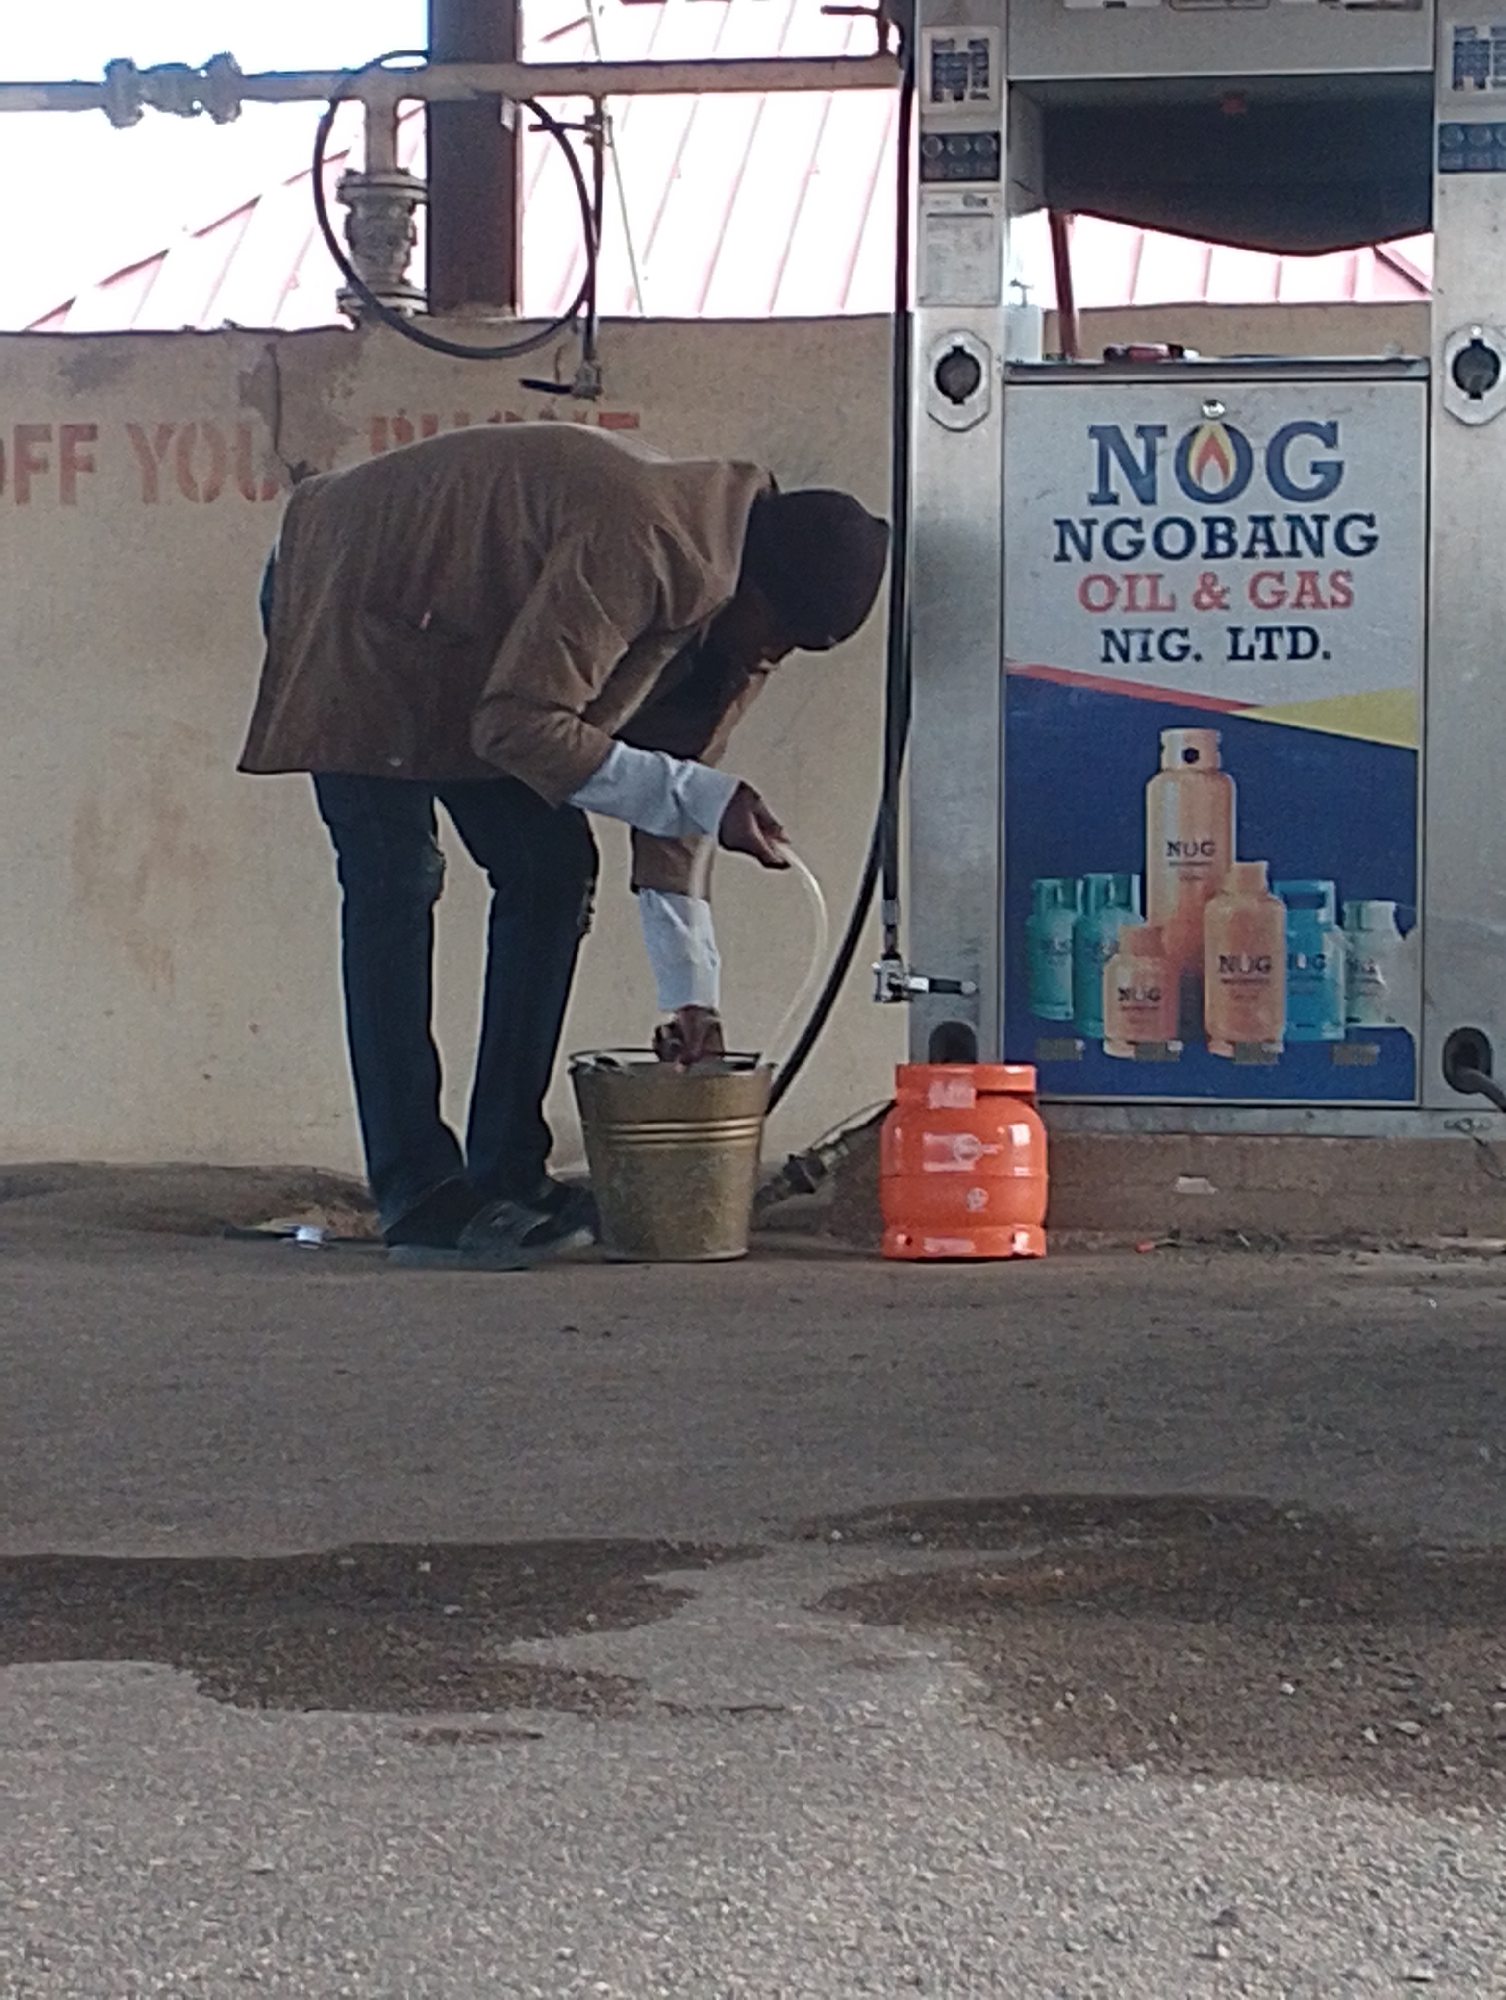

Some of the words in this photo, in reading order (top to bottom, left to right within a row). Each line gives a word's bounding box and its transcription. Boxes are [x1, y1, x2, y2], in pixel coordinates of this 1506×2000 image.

[0, 423, 98, 505] FF
[125, 422, 300, 503] YOU
[1087, 420, 1345, 506] NOG
[1053, 512, 1380, 563] NGOBANG
[1077, 573, 1177, 614] OIL
[1191, 571, 1231, 612] &
[1247, 568, 1355, 611] GAS
[1100, 627, 1203, 663] NIG.
[1226, 625, 1332, 661] LTD.
